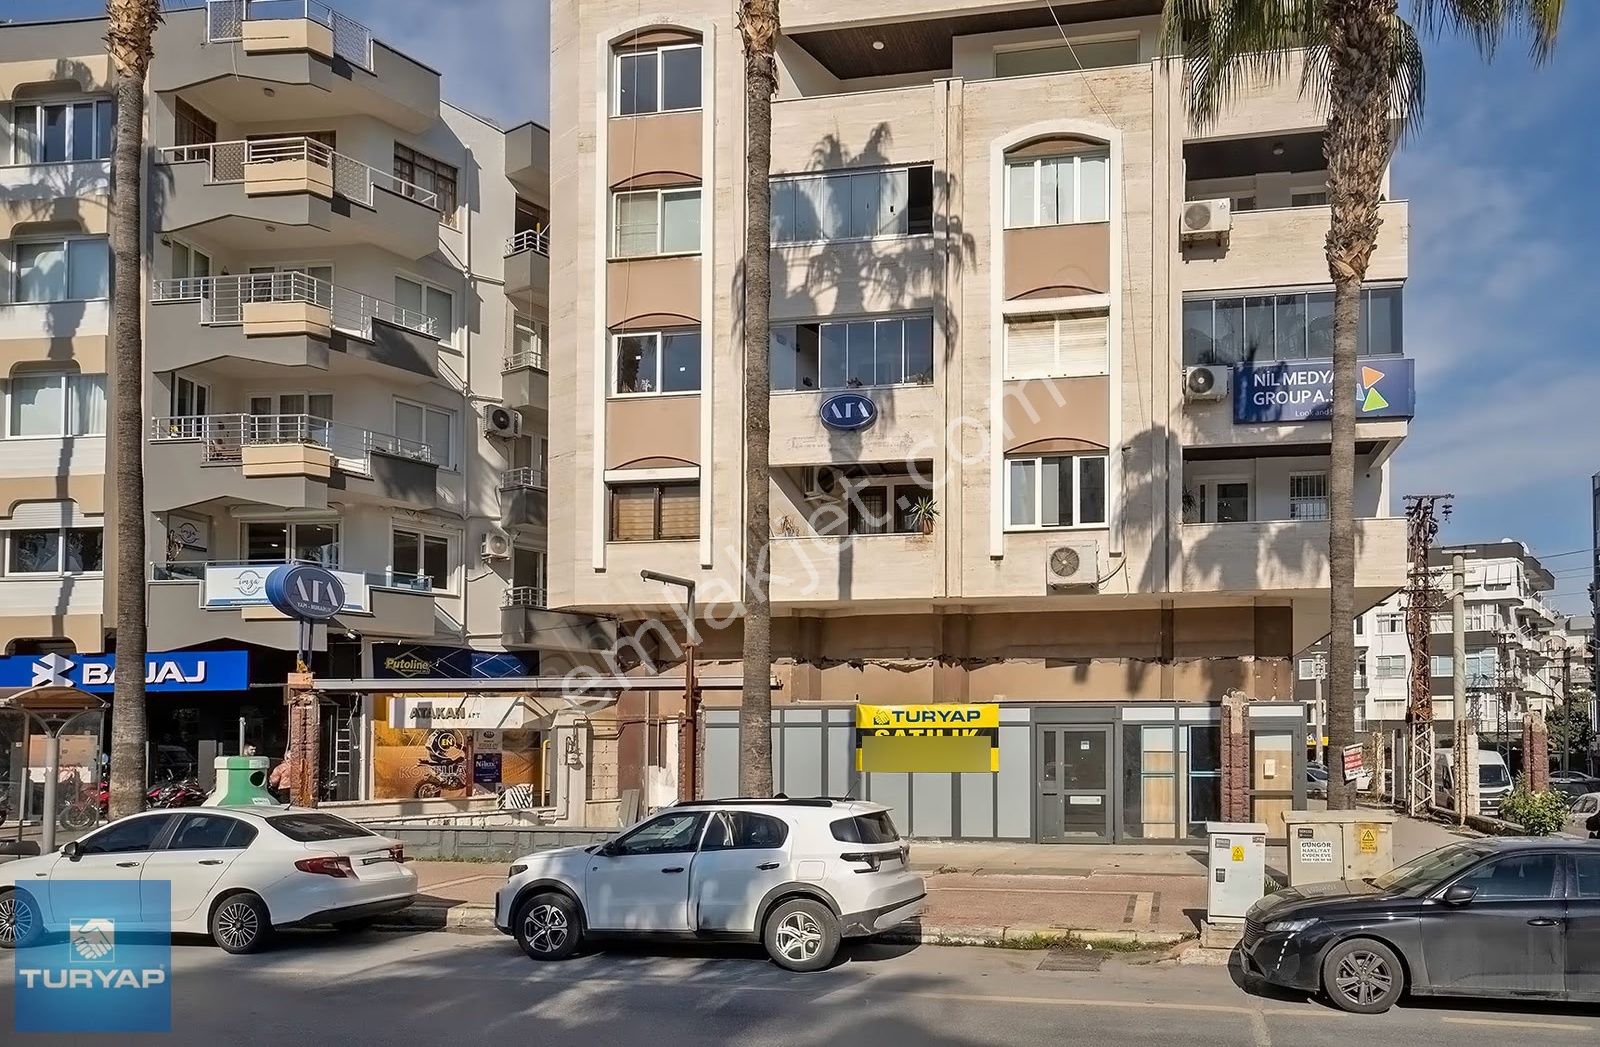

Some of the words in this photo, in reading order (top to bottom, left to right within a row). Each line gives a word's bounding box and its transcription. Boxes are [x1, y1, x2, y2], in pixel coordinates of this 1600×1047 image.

[1254, 371, 1280, 387] NİL
[1253, 389, 1311, 405] GROUP
[386, 658, 429, 670] Putoline
[82, 660, 206, 685] BJAJ
[409, 706, 466, 720] ATAKAN
[892, 710, 981, 723] TURYAP
